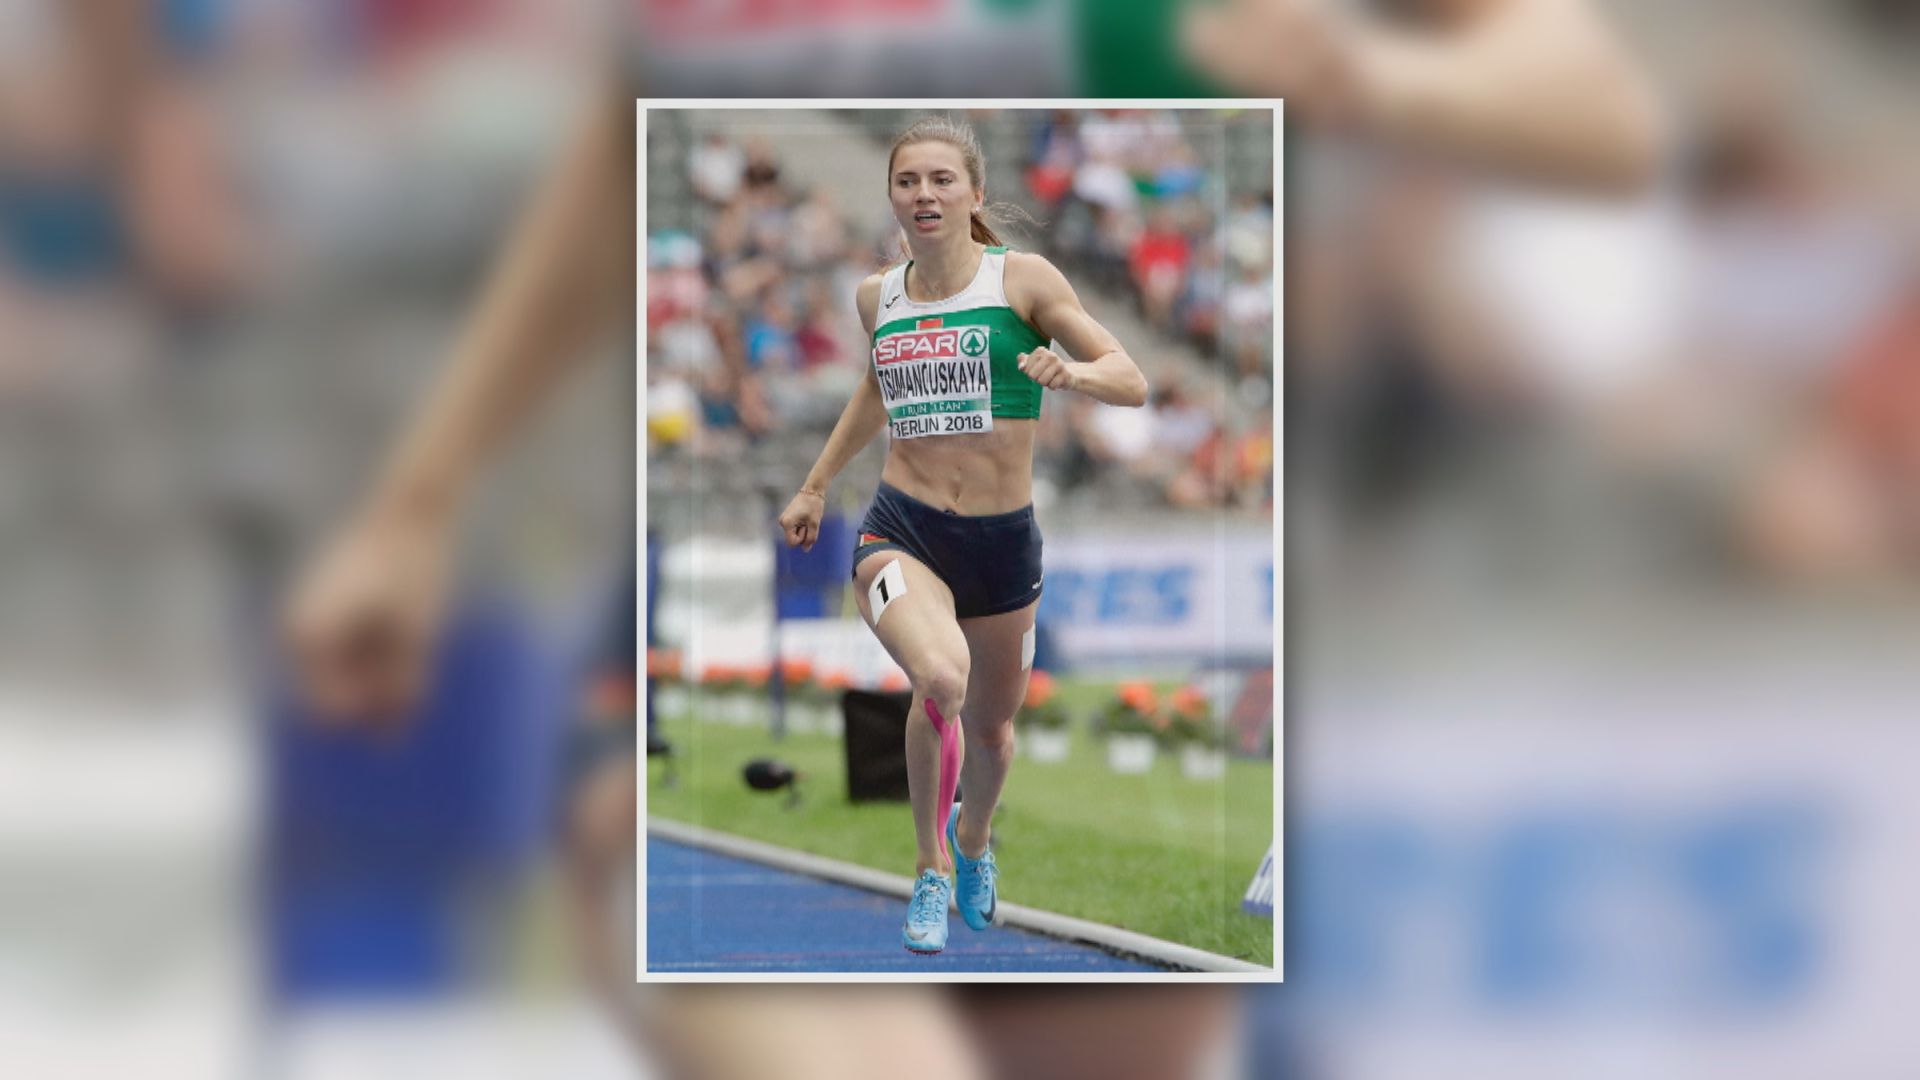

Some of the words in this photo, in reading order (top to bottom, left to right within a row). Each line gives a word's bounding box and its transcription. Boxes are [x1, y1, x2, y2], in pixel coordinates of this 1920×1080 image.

[878, 334, 955, 361] SPAR
[944, 415, 983, 431] 2018
[876, 576, 889, 605] 1
